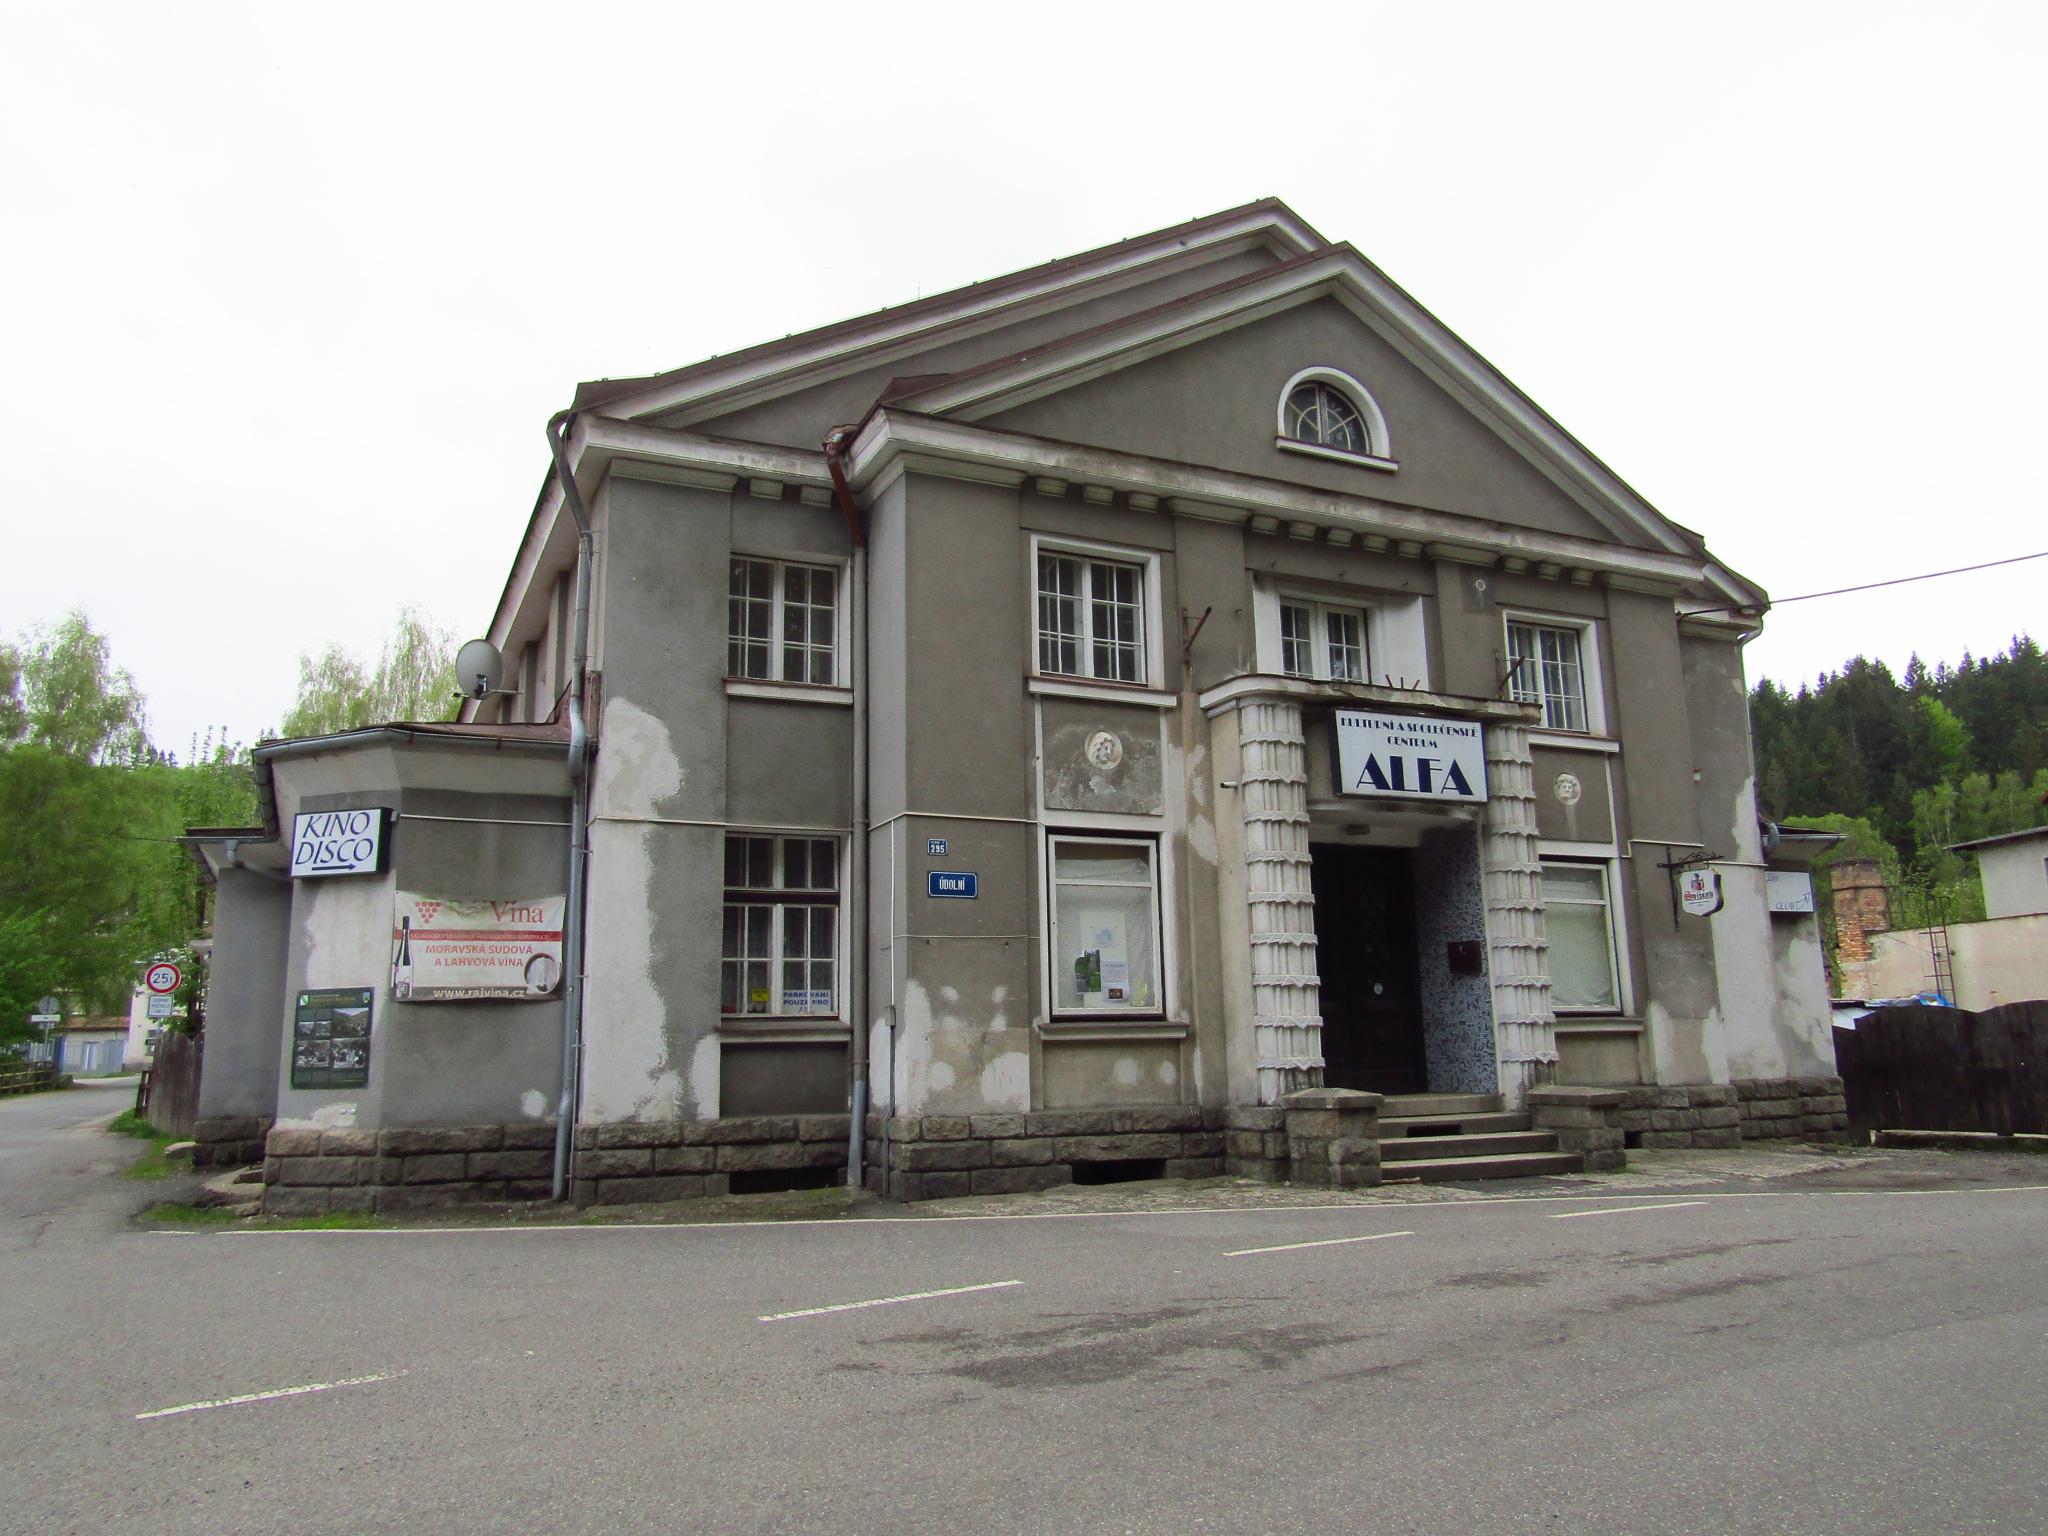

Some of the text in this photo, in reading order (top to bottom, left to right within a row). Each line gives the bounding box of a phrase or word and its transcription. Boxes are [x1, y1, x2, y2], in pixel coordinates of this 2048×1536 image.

[1341, 717, 1479, 737] KULTURNÍ A SPOLEČENSKÉ
[1387, 735, 1438, 748] CENTRUM
[1356, 752, 1474, 796] ALFA
[302, 811, 371, 838] KINO
[295, 838, 374, 865] DISCO
[930, 845, 945, 853] 295
[939, 876, 965, 890] ÚDOLNÍ
[490, 900, 544, 924] Vína
[426, 944, 487, 954] MORAVSKÁ
[434, 958, 441, 967] A
